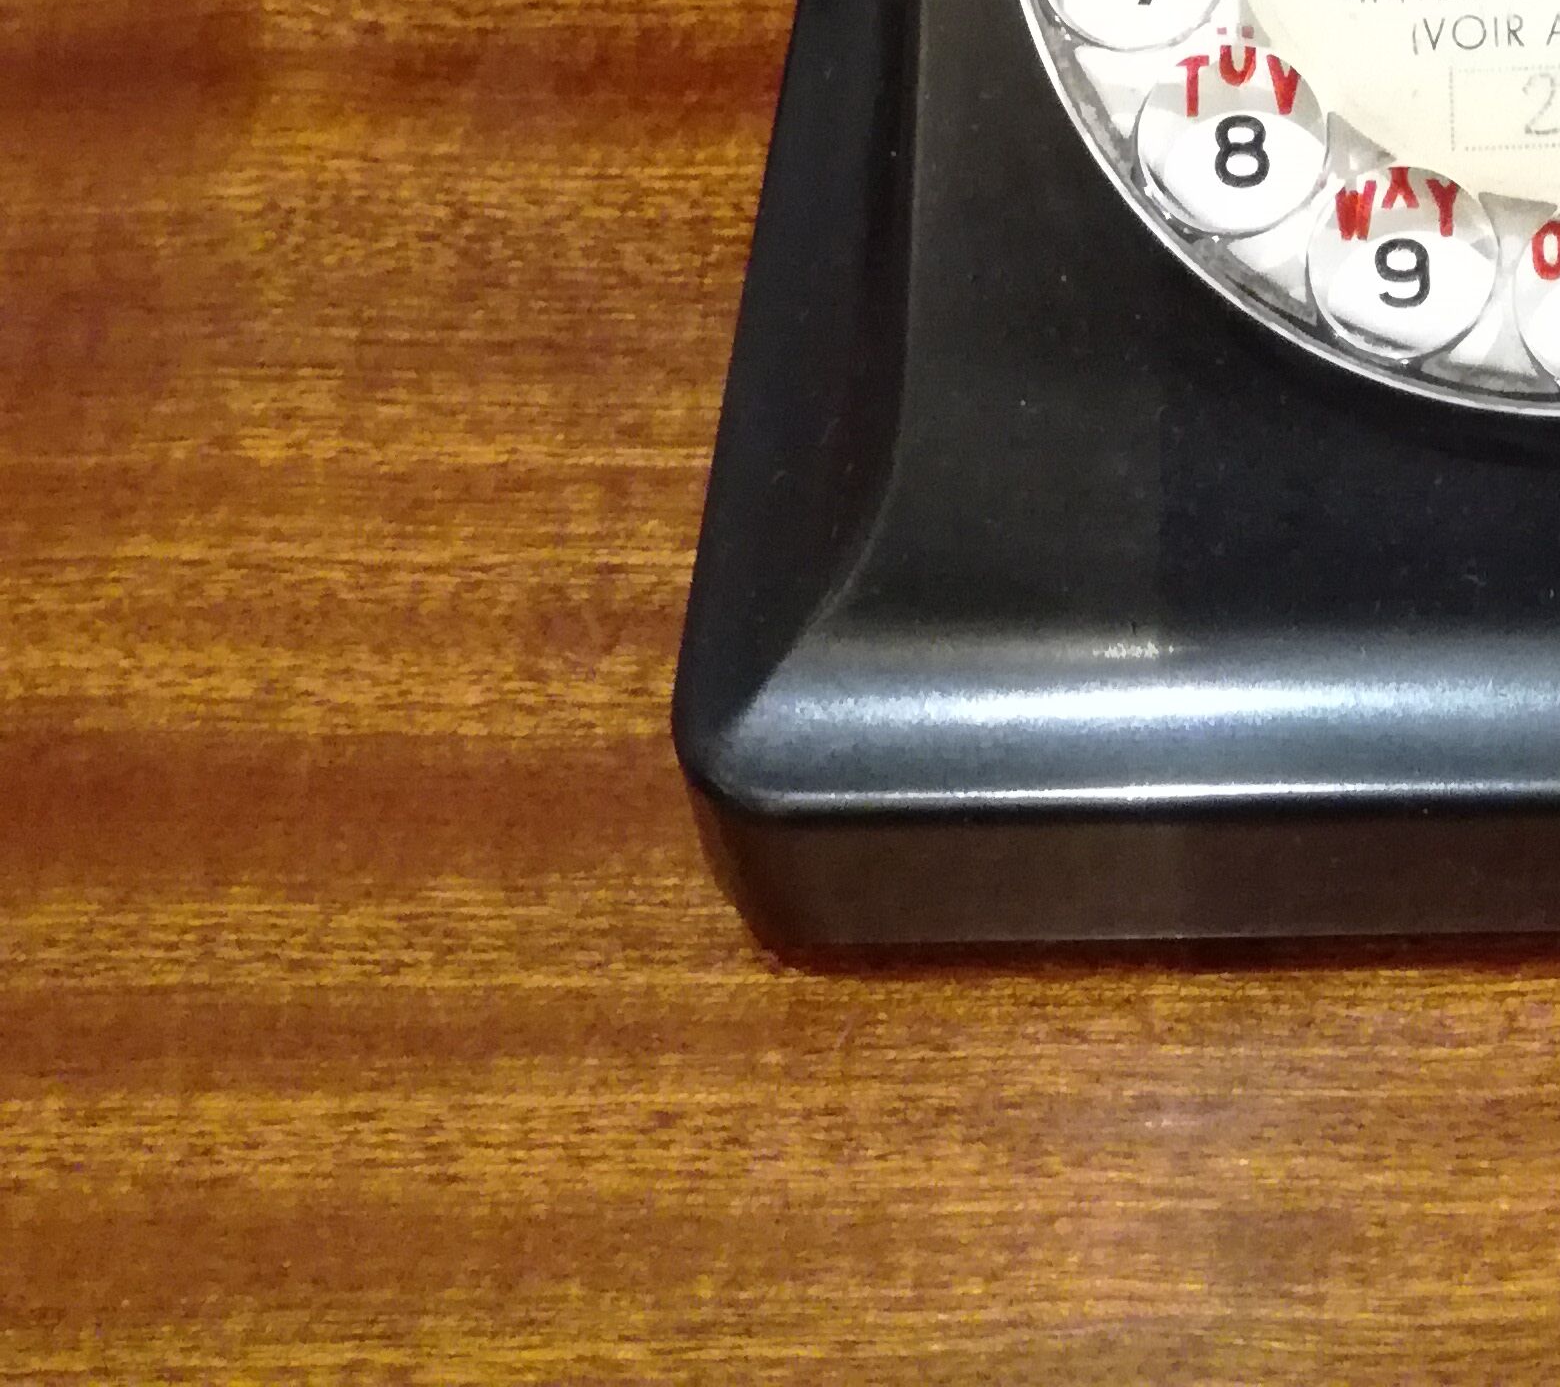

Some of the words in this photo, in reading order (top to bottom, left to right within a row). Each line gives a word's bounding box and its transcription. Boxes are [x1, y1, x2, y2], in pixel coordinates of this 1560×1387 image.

[1411, 11, 1526, 57] (VOIR
[1213, 113, 1271, 190] 8
[1373, 237, 1432, 309] 9
